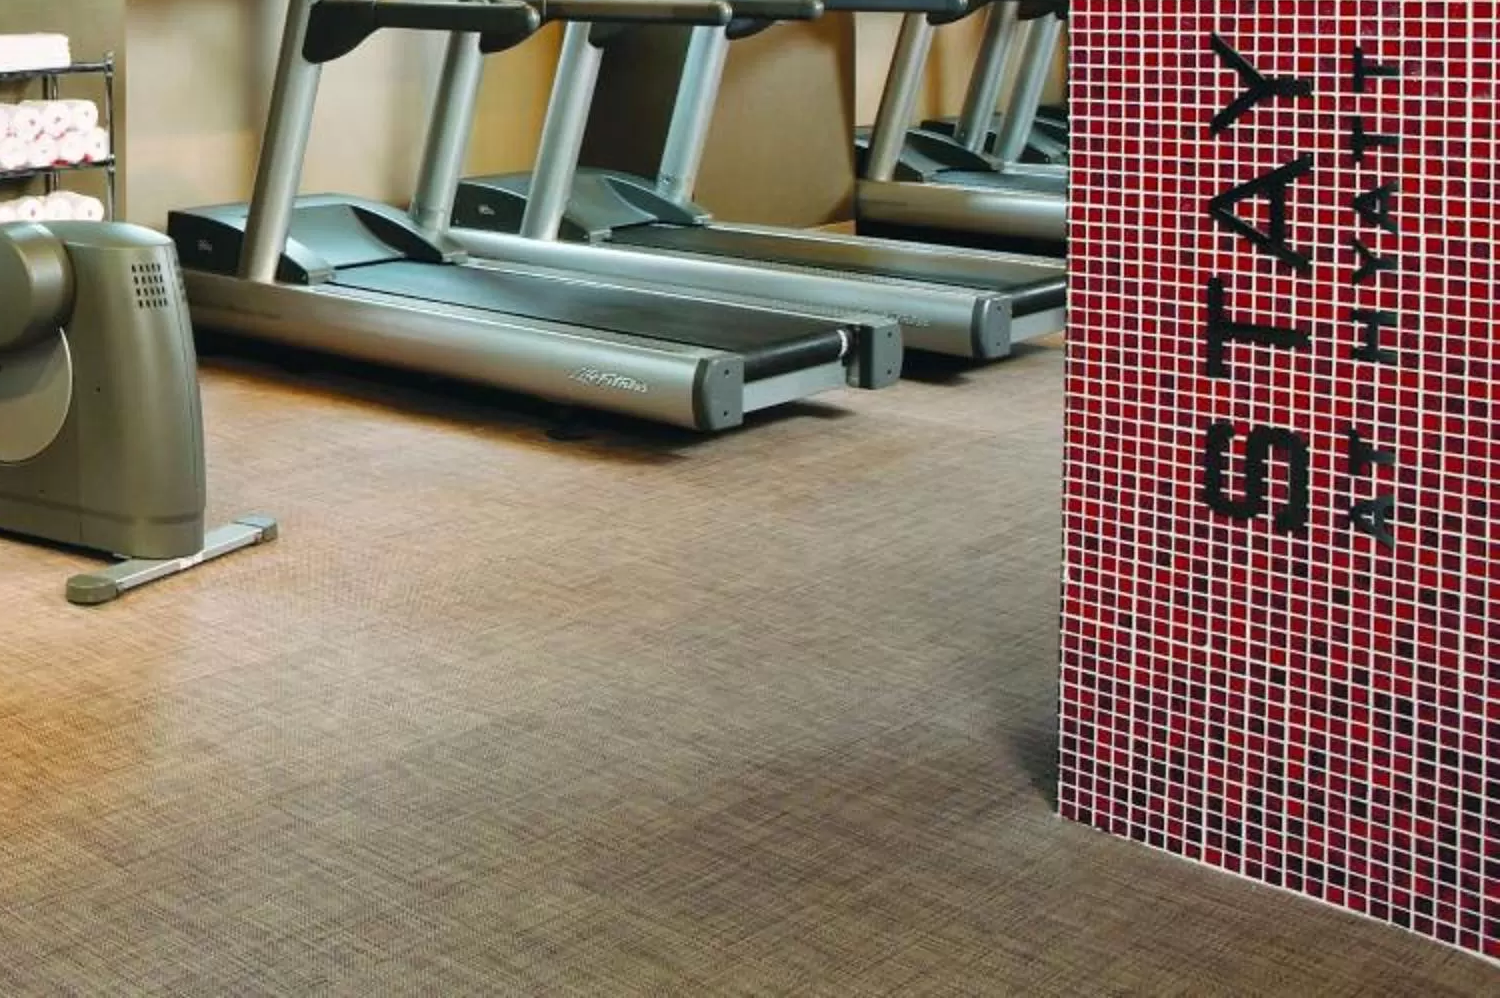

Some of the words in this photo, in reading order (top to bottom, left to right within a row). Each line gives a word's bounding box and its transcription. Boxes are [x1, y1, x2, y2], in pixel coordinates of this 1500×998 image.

[1204, 31, 1312, 534] STAY
[1349, 46, 1399, 363] HYATT
[1348, 426, 1397, 548] AT
